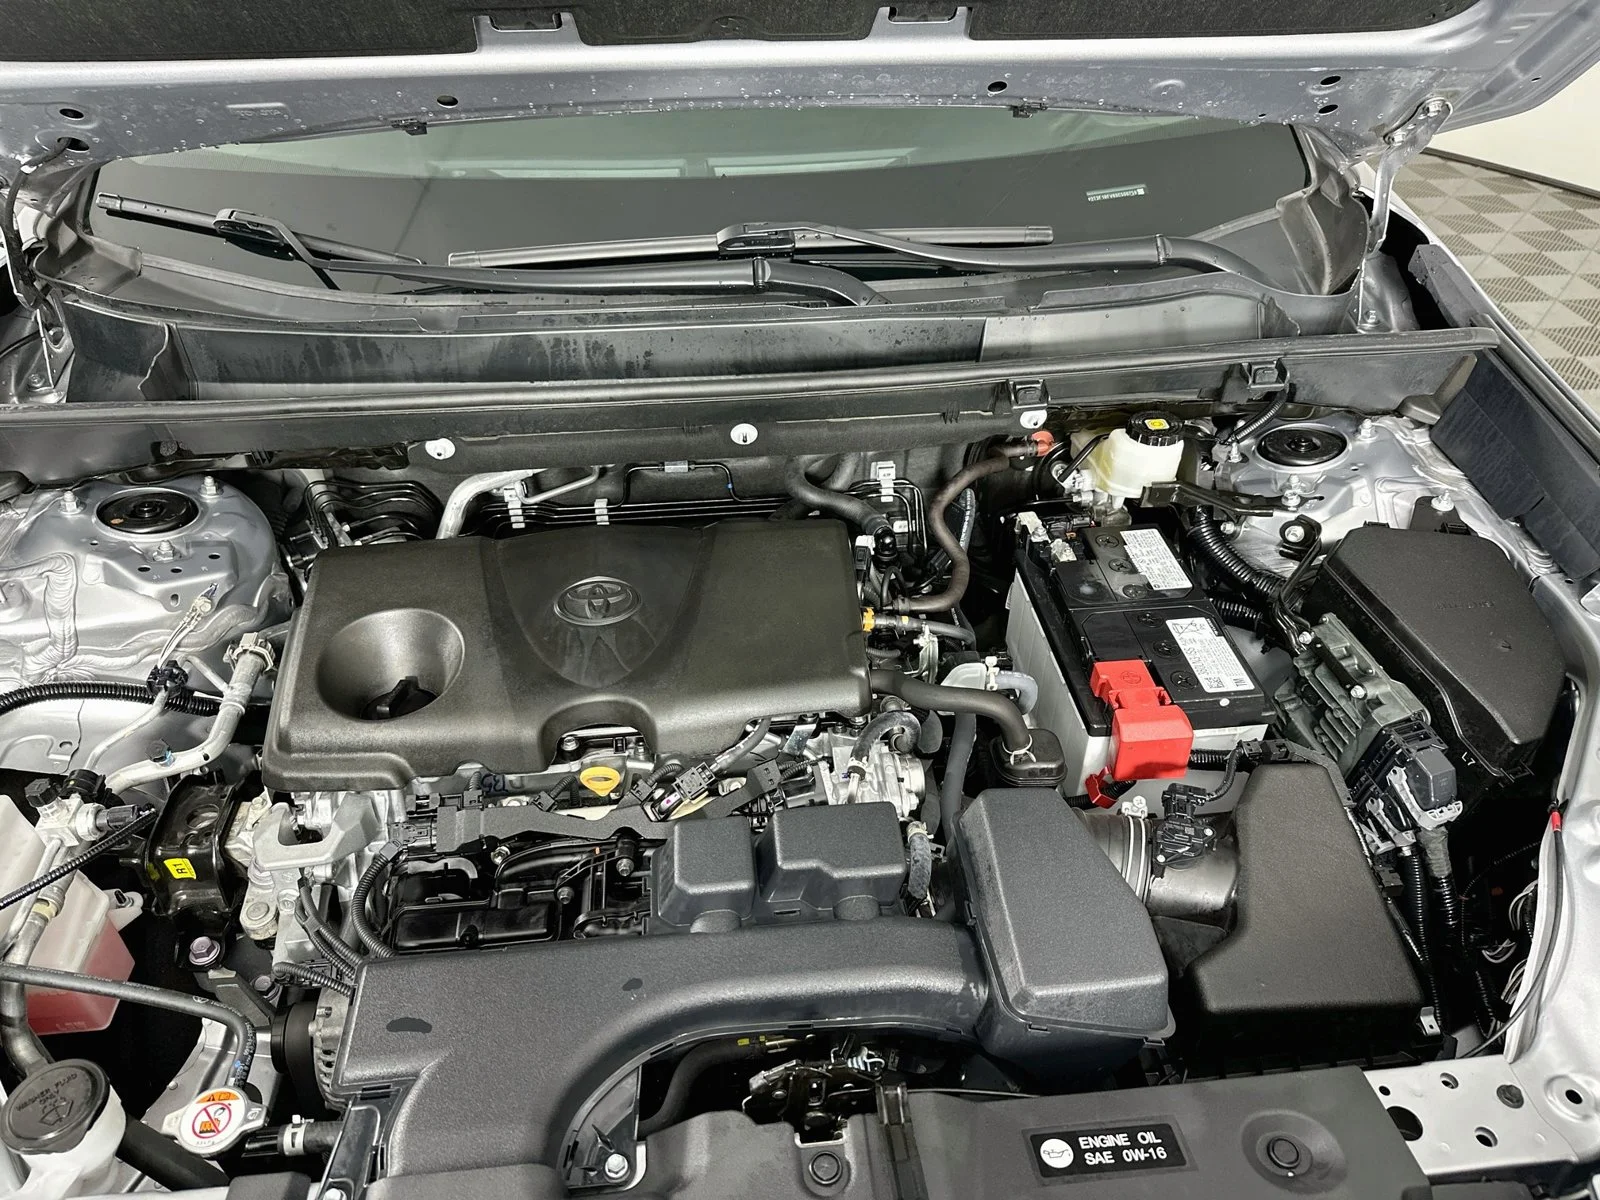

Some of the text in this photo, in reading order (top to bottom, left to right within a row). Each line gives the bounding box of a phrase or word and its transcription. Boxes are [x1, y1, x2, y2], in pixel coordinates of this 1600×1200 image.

[1461, 751, 1476, 766] L7
[172, 863, 188, 874] R1
[54, 1073, 78, 1088] FLUID
[40, 1088, 59, 1104] ONLY
[1078, 1131, 1162, 1149] ENGINE OIL
[1084, 1146, 1168, 1165] SAE 0W-16
